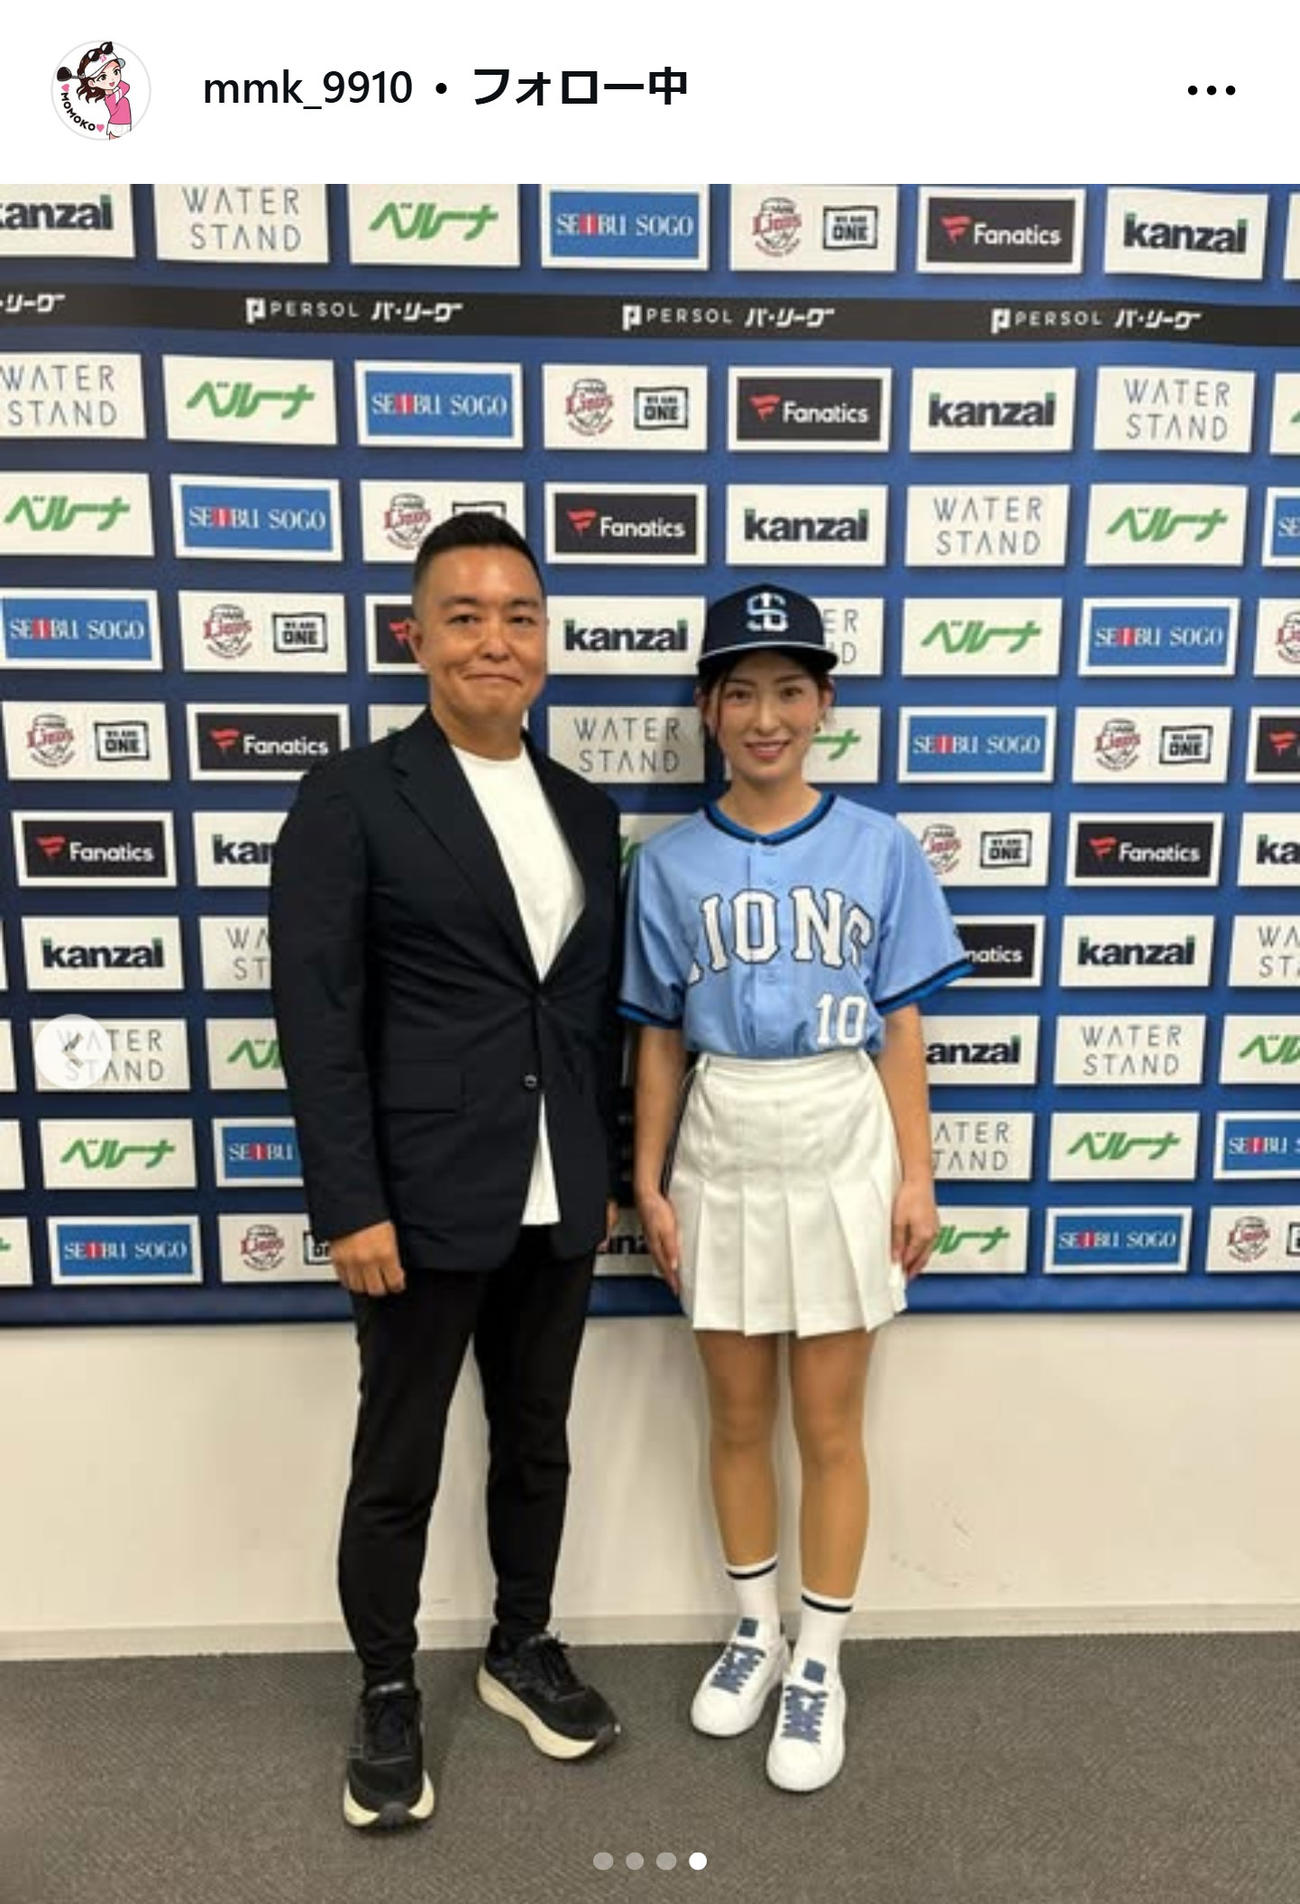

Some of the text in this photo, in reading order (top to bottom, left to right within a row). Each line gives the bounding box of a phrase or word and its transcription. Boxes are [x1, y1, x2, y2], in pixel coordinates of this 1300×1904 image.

[0, 195, 113, 230] anzai
[182, 187, 298, 215] WATER
[368, 202, 499, 241] ベルーナ
[557, 212, 694, 237] SEIBU SOGO
[832, 225, 868, 241] ONE
[191, 223, 301, 252] STAND
[974, 223, 1062, 245] Fanatics
[1124, 214, 1247, 253] kanzai
[0, 294, 65, 312] ・リーグ
[270, 301, 359, 317] PERSOL
[647, 308, 732, 324] PERSOL
[1015, 311, 1102, 326] PERSOL
[0, 365, 114, 392] WATER
[186, 381, 315, 420] ベルーナ
[1124, 379, 1230, 407] WATER
[8, 400, 117, 427] STAND
[371, 394, 507, 417] SEIBU SOGO
[644, 406, 678, 420] ONE
[782, 402, 869, 423] Fanatics
[929, 393, 1056, 428] kanzai
[1126, 413, 1227, 442] STAND
[4, 496, 130, 531] ベルーナ
[189, 507, 326, 529] SEIBU SOGO
[934, 496, 1042, 522] WATER
[601, 517, 685, 537] Fanatics
[745, 509, 868, 542] kanzai
[1106, 507, 1228, 542] ベルーナ
[937, 530, 1040, 556] STAND
[9, 619, 144, 640] SEIBU SOGO
[282, 630, 317, 645] ONE
[564, 620, 688, 652] kanzai
[921, 620, 1042, 653] ベルーナ
[1095, 627, 1223, 647] SEIBU SOGO
[574, 717, 681, 740] WATER
[105, 739, 139, 753] ONE
[243, 735, 329, 755] Fanatics
[913, 736, 1040, 753] SEIBU SOGO
[1169, 742, 1203, 756] ONE
[578, 749, 679, 773] STAND
[70, 842, 154, 861] Fanatics
[989, 848, 1022, 860] ONE
[1119, 842, 1200, 862] Fanatics
[687, 885, 874, 986] IONS
[42, 939, 164, 968] kanzai
[966, 944, 1023, 964] natics
[1078, 937, 1195, 966] kanzai
[815, 993, 868, 1048] 10
[1081, 1024, 1181, 1047] WATER
[926, 1036, 1020, 1064] anzai
[1083, 1054, 1179, 1076] STAND
[934, 1121, 1010, 1144] ATER
[60, 1139, 176, 1169] ベルーナ
[229, 1144, 292, 1161] SEIBU
[1067, 1132, 1180, 1160] ベルーナ
[1229, 1137, 1287, 1154] SEIBU
[934, 1151, 1009, 1172] TAND
[1058, 1231, 1176, 1248] SEIBU SOGO
[64, 1242, 187, 1261] SEIBU SOGO
